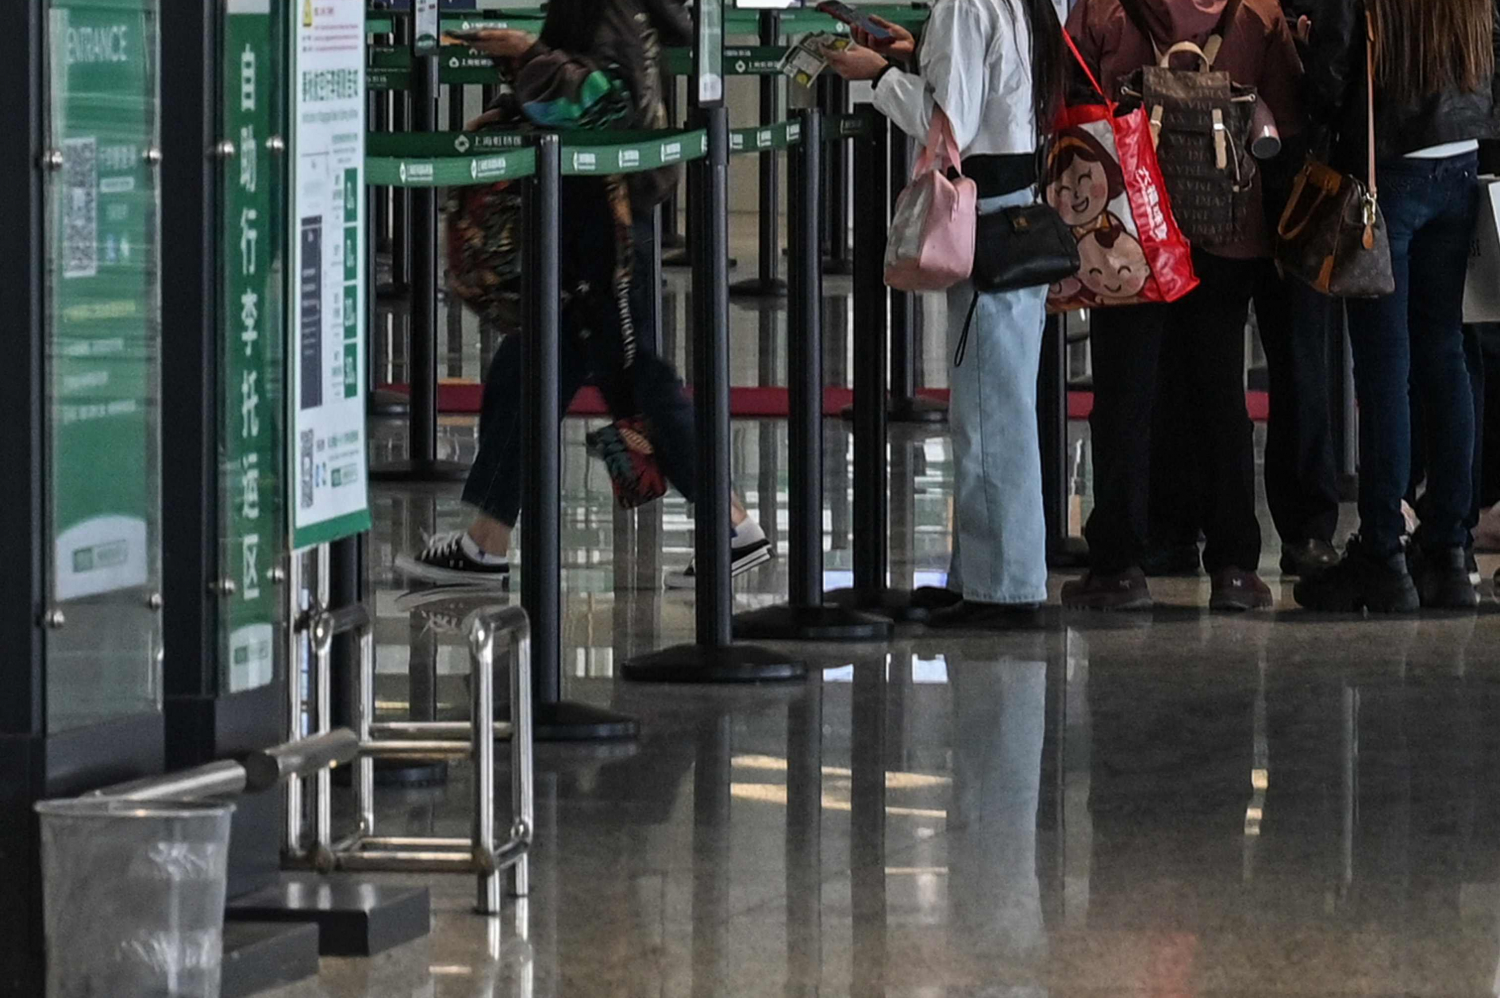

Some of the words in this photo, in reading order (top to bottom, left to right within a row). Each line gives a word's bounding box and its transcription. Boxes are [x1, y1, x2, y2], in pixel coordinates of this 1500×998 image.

[67, 25, 130, 62] ENTRANCE
[238, 41, 261, 602] 自助行李托运区
